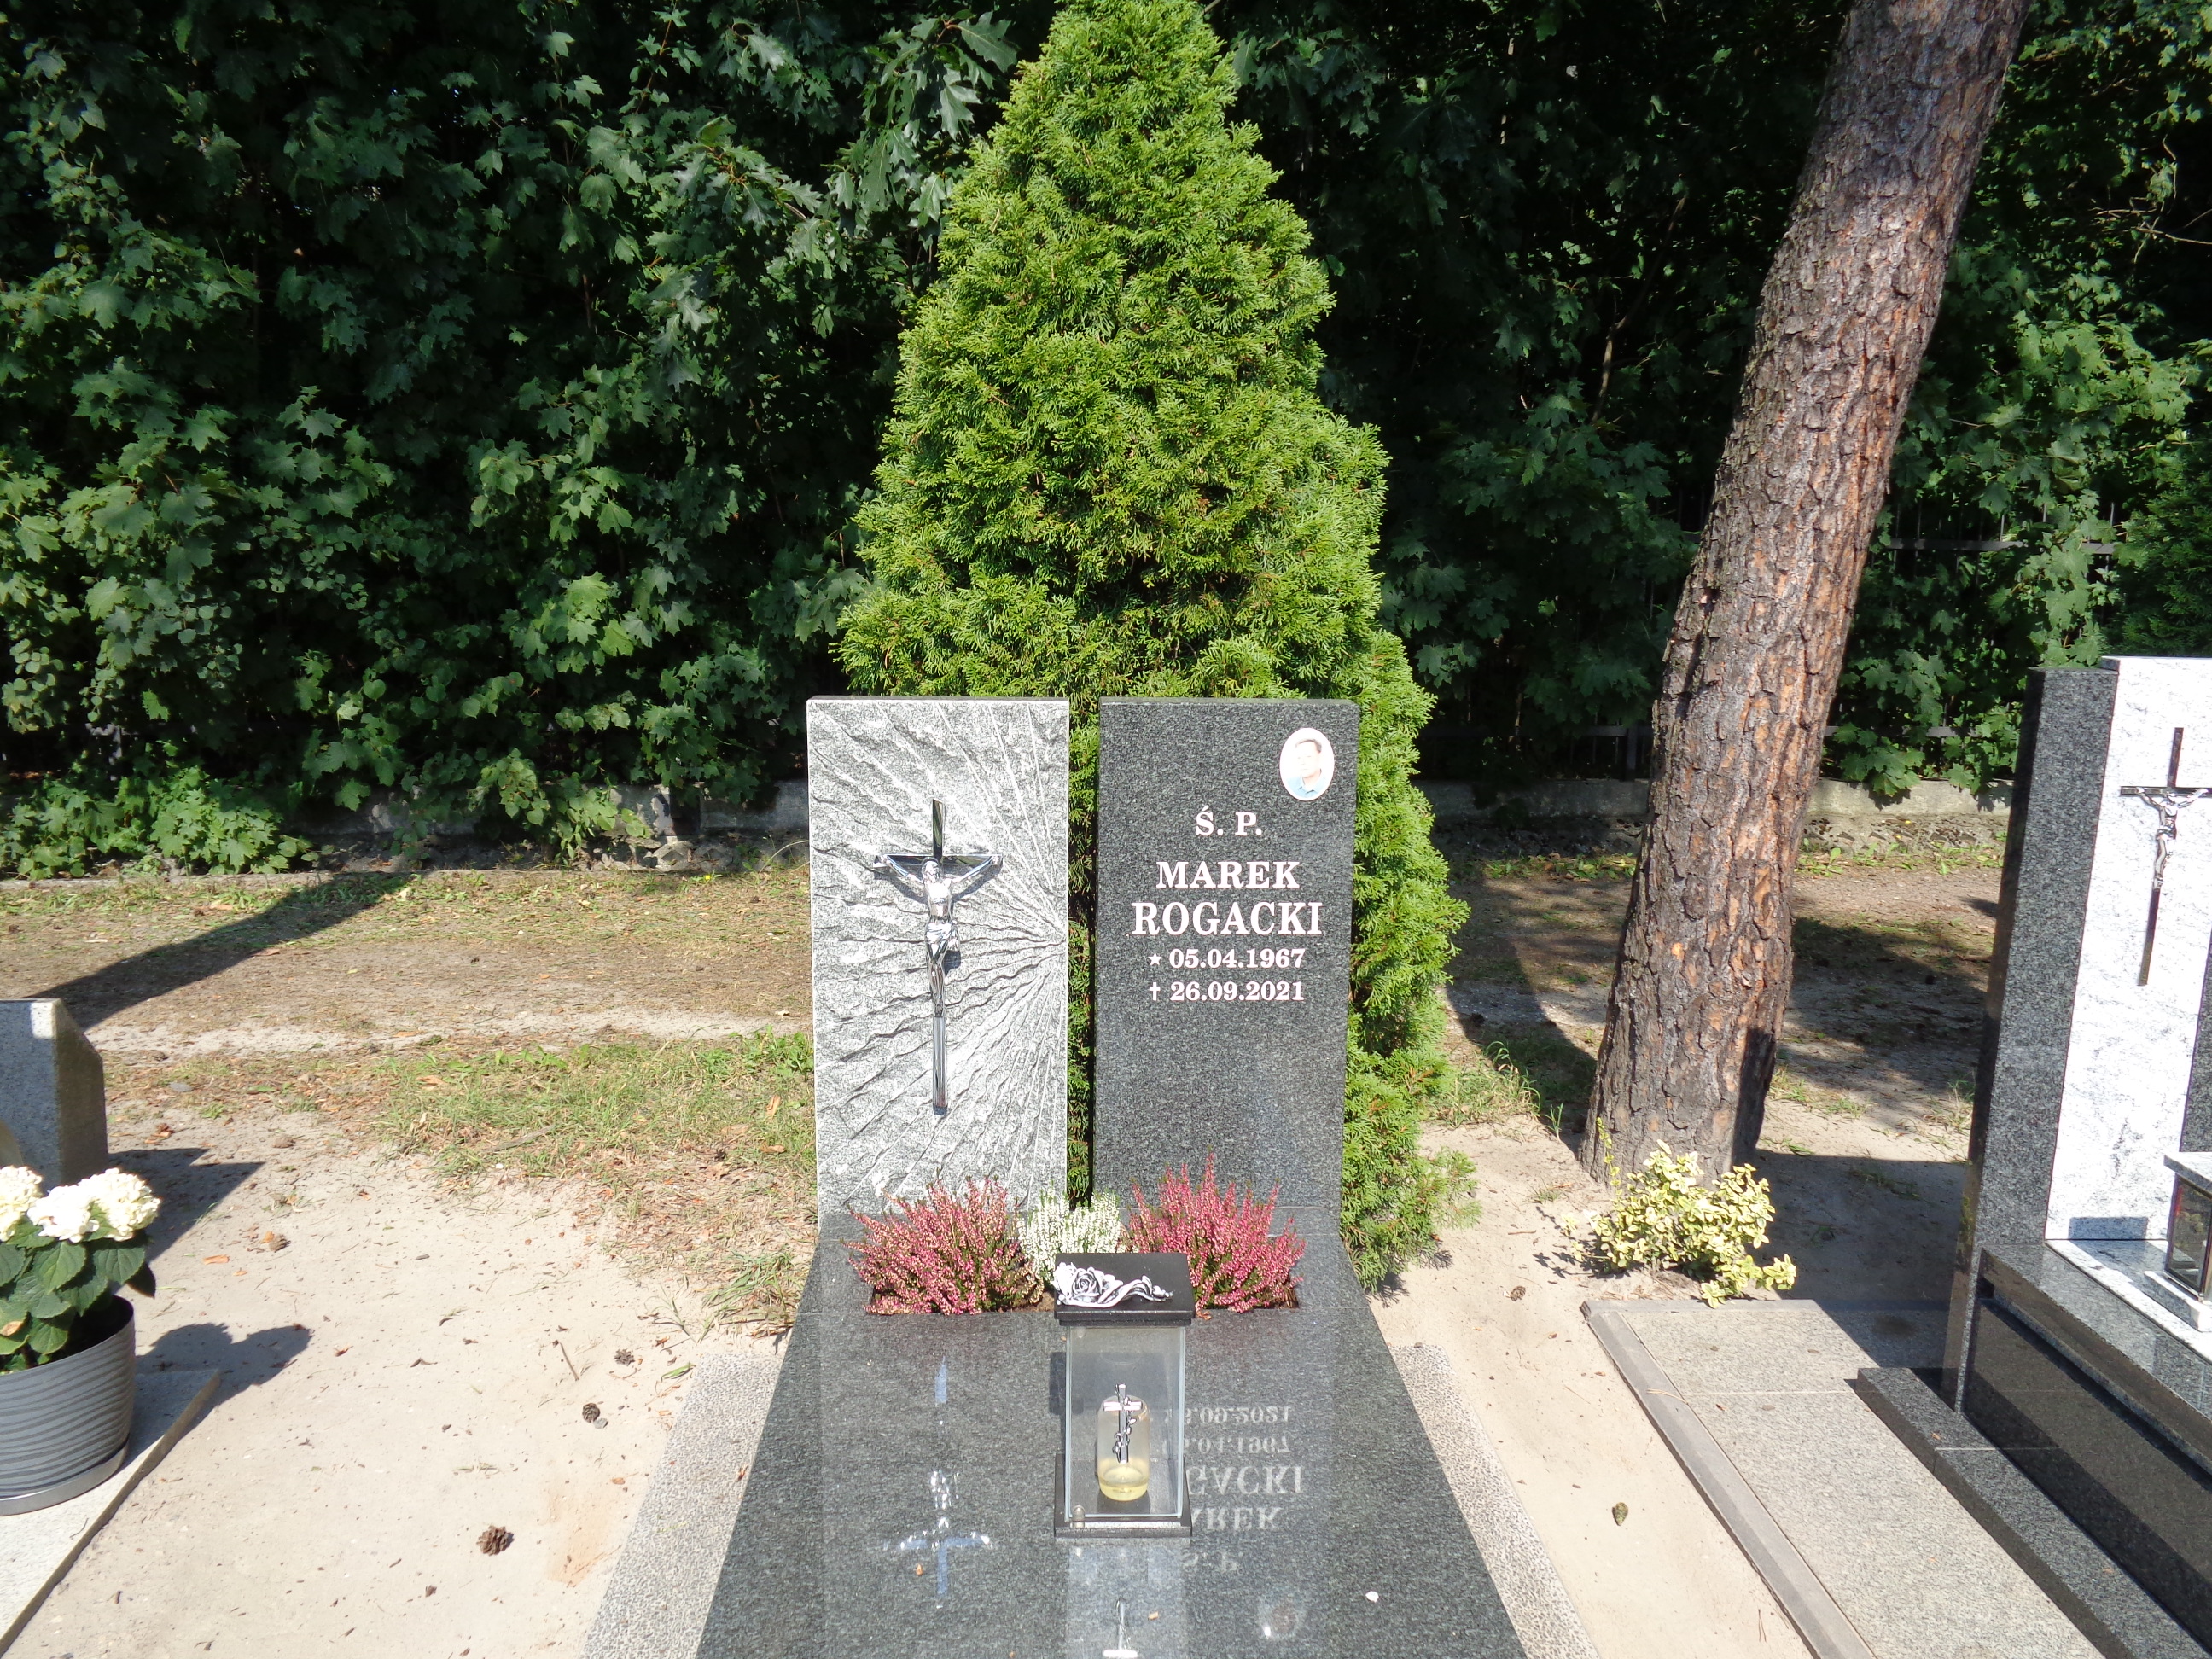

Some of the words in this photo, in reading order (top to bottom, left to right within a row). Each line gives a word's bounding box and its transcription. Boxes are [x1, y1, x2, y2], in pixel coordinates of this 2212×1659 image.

[1196, 805, 1224, 836] Ś.
[1234, 812, 1262, 836] P.
[1155, 860, 1300, 889] MAREK
[1132, 901, 1323, 936] ROGACKI
[1168, 947, 1306, 969] 05.04.1967
[1169, 981, 1305, 1001] 26.09.2021
